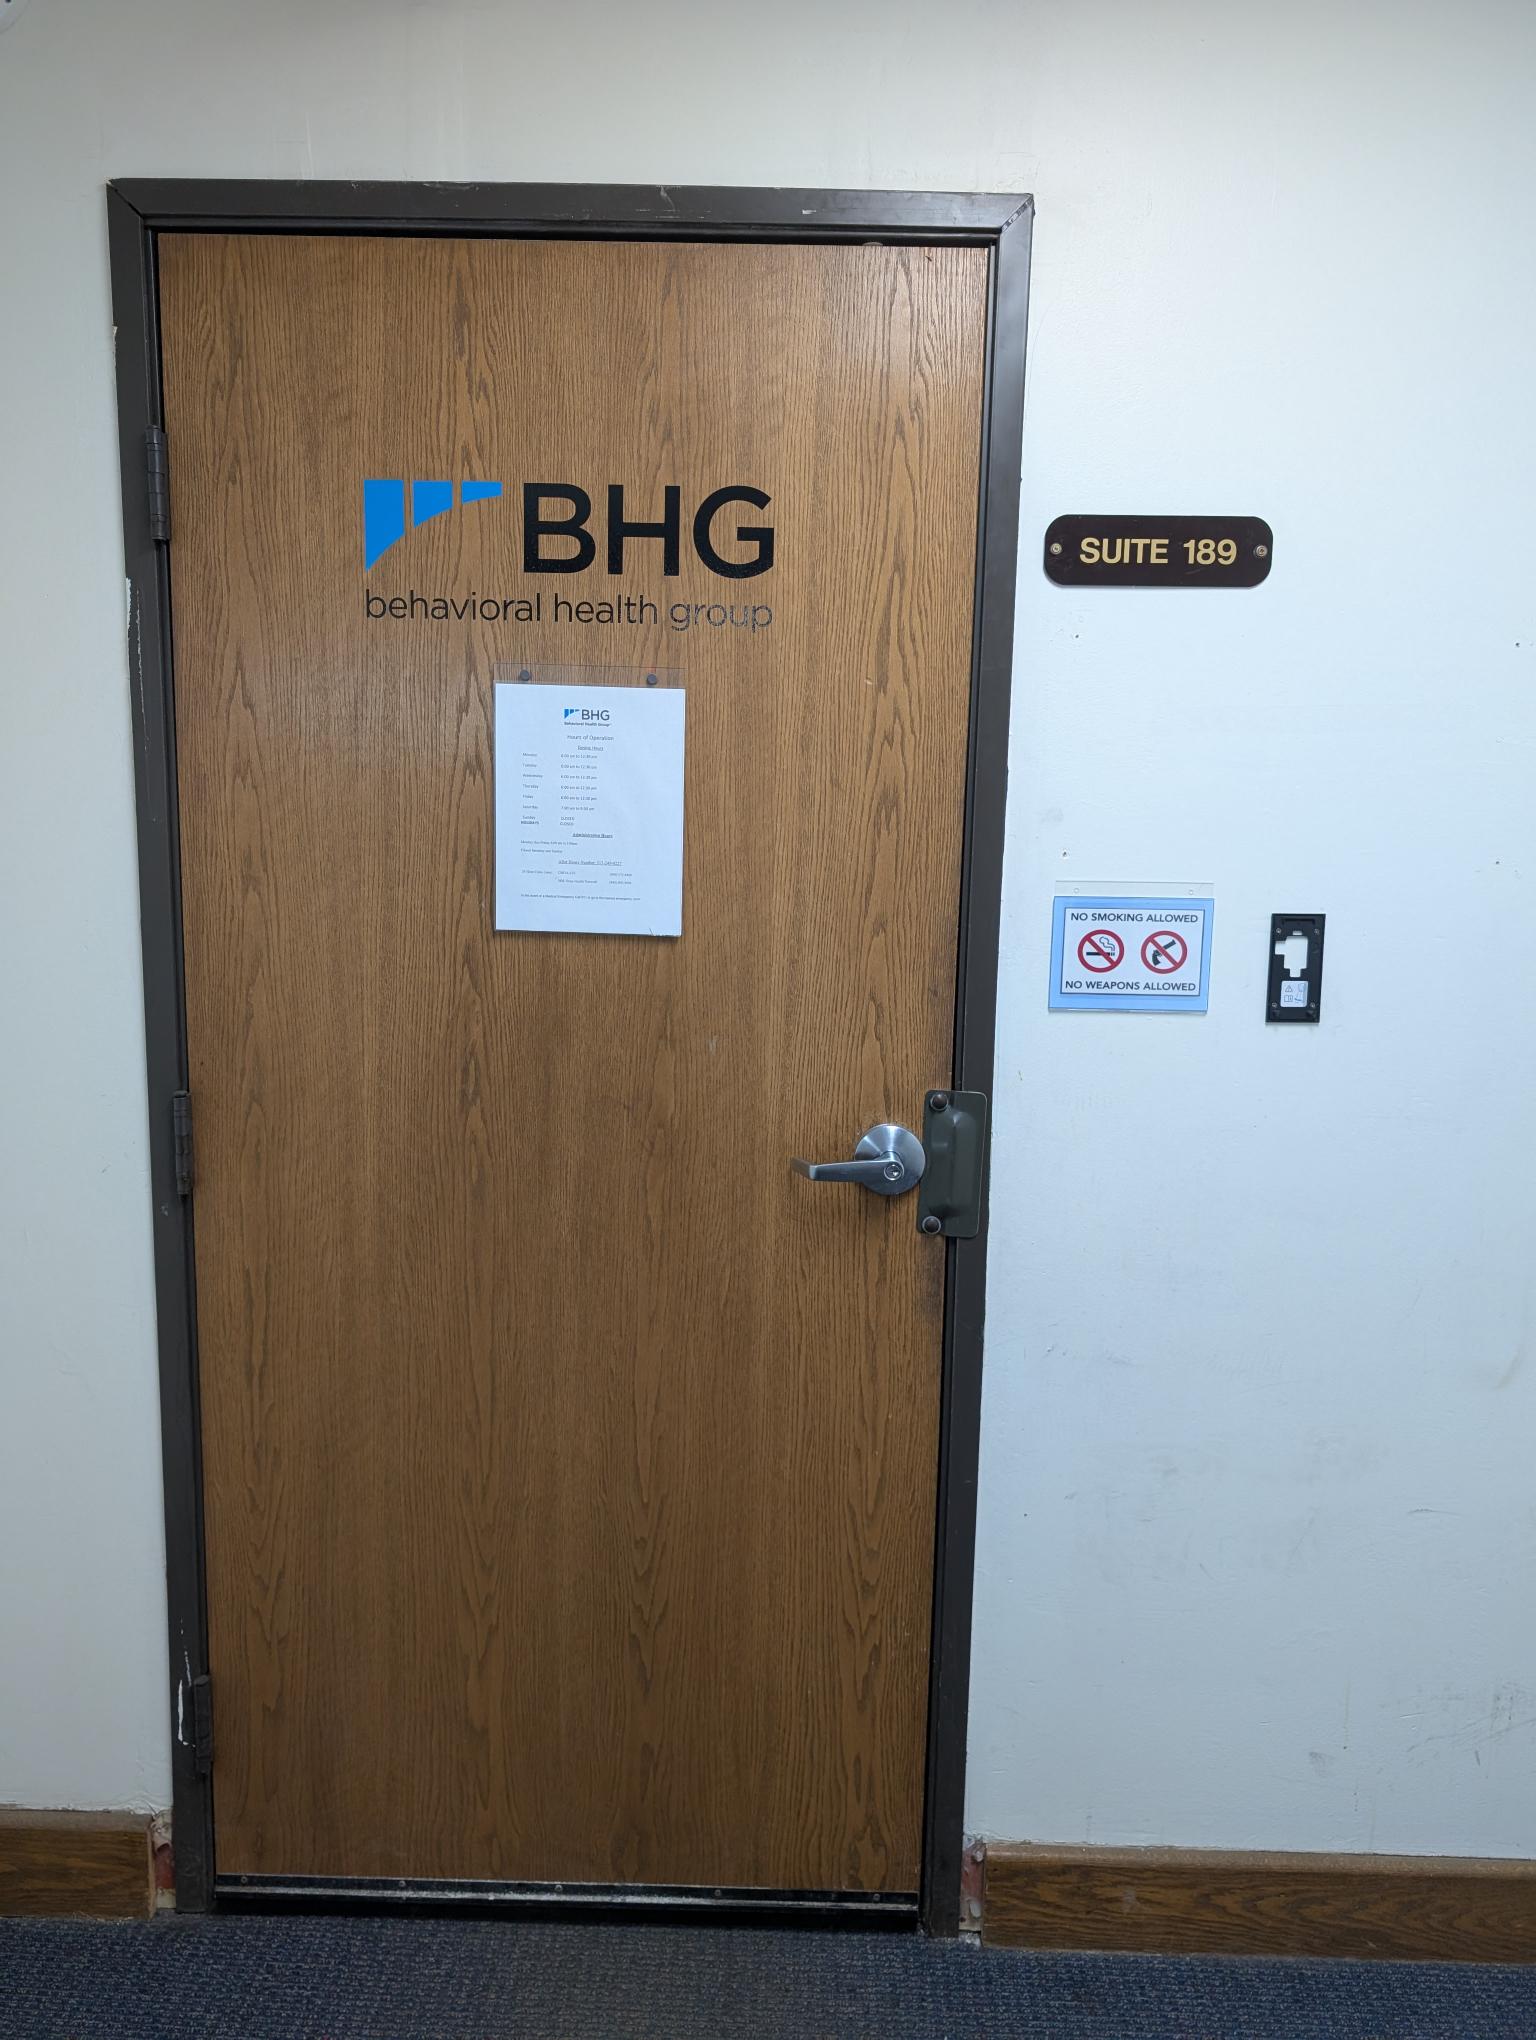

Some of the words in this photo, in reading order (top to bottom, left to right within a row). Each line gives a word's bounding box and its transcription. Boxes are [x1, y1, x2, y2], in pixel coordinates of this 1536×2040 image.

[523, 482, 775, 579] BHG
[1079, 537, 1170, 564] SUITE
[1183, 539, 1237, 565] 189
[366, 589, 541, 622] behavioral
[554, 593, 658, 625] health
[669, 602, 773, 633] group
[581, 709, 610, 721] BHG
[1071, 913, 1088, 921] NO
[1091, 913, 1144, 922] SMOKING
[1146, 914, 1198, 923] ALLOWED
[1065, 980, 1083, 989] NO
[1086, 981, 1140, 990] WEAPONS
[1143, 982, 1196, 991] ALLOWED
